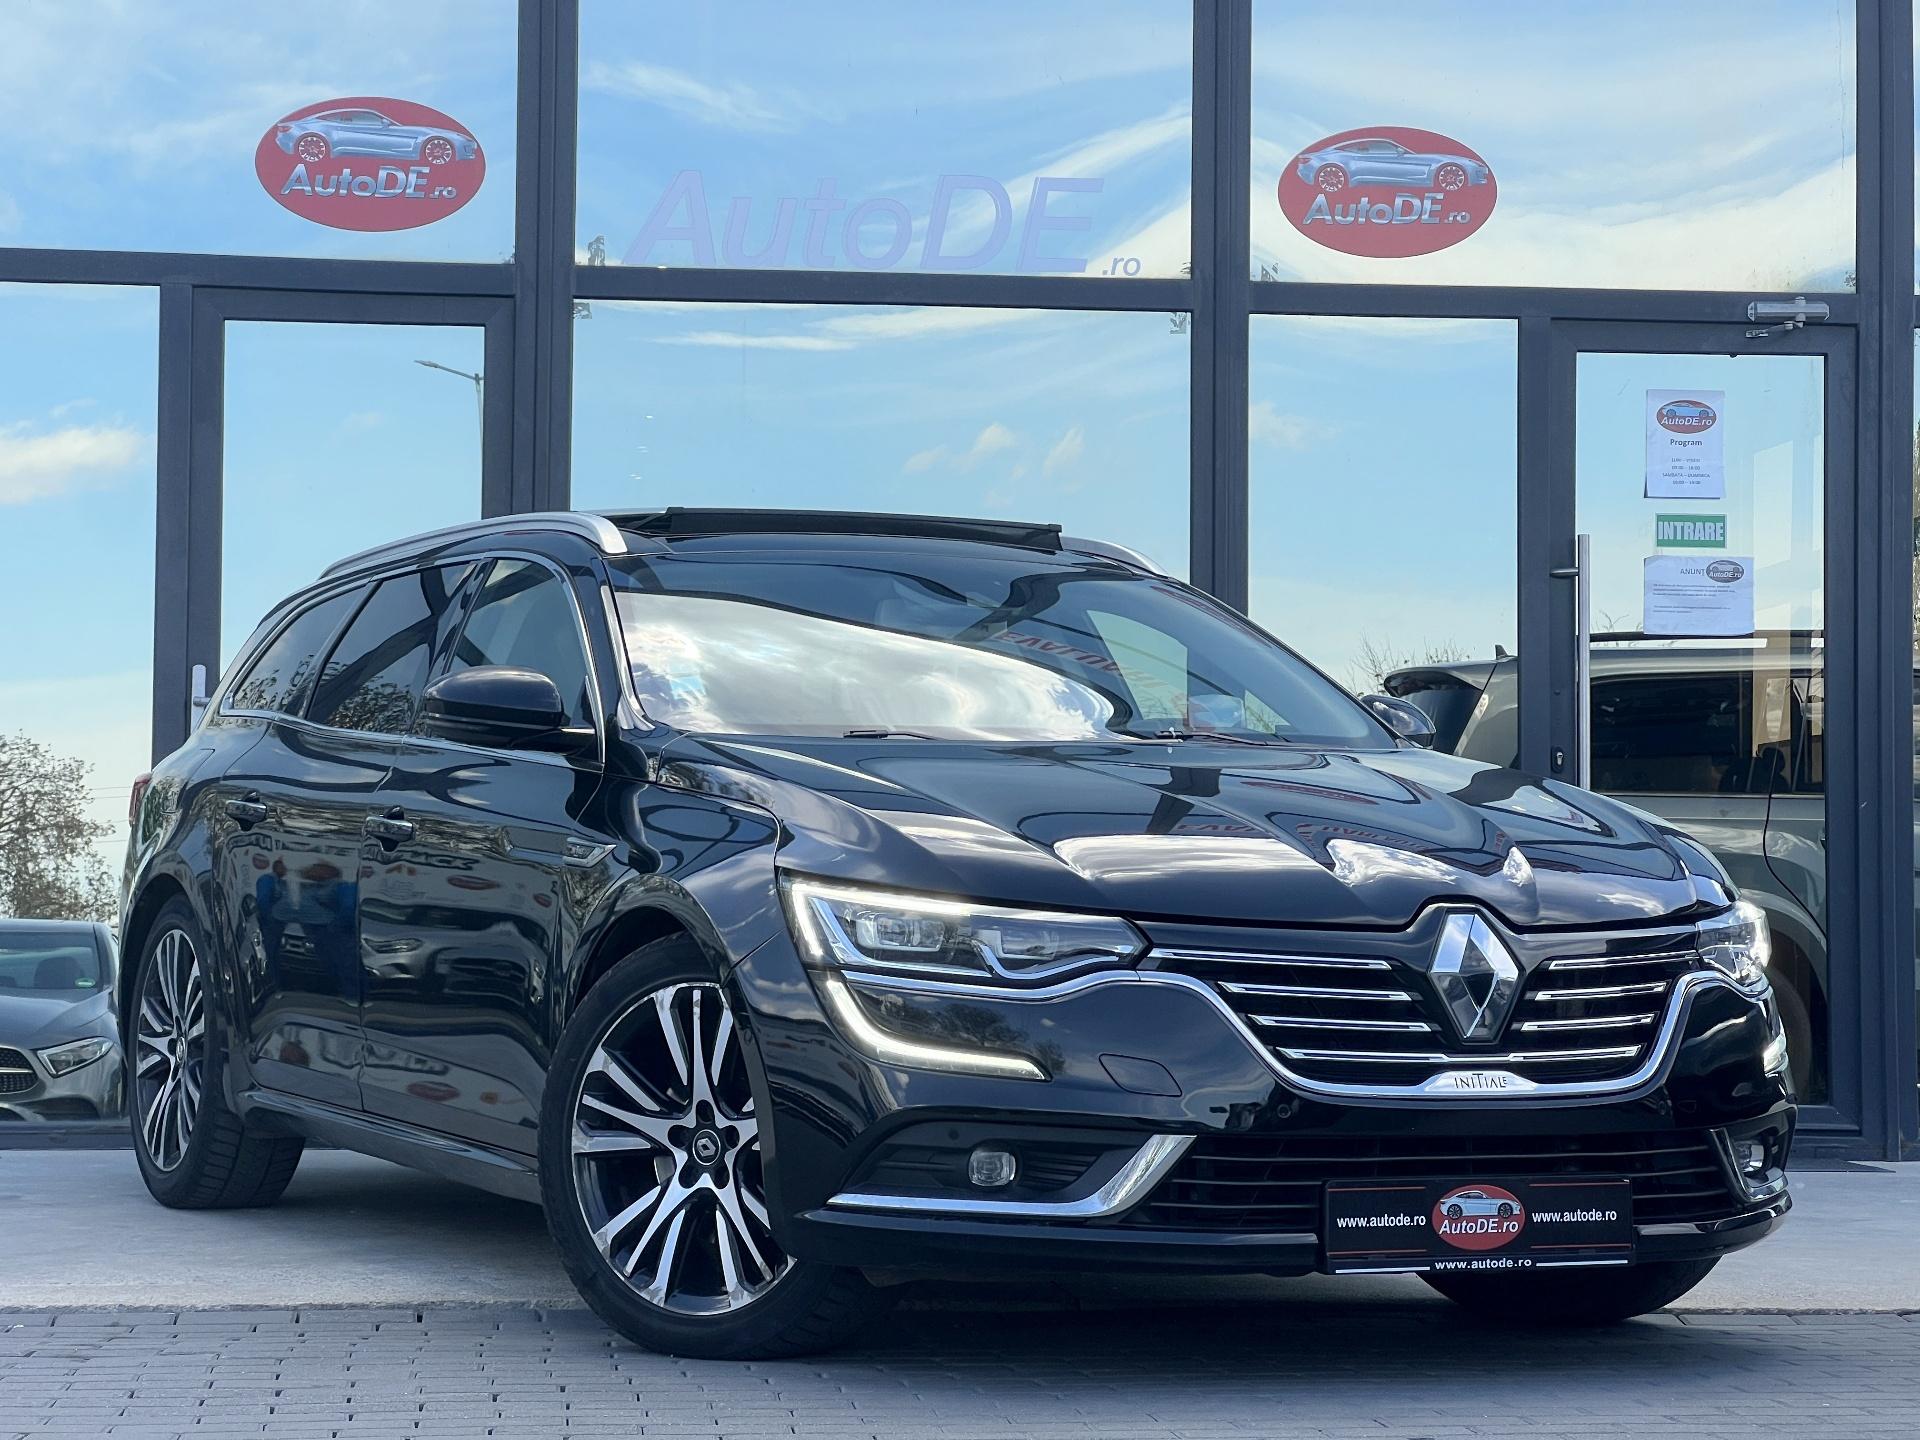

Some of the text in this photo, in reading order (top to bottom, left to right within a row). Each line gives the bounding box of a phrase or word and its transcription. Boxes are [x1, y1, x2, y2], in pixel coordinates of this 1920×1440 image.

[1660, 416, 1713, 426] AutoDE.ro
[1670, 438, 1703, 447] Program
[1657, 521, 1724, 540] INTRARE
[1454, 1073, 1507, 1088] INITIALE
[1337, 1212, 1426, 1228] www.autode.ro
[1532, 1207, 1617, 1224] www.autode.ro
[1439, 1218, 1519, 1235] AutoDE.ro
[1434, 1257, 1532, 1271] www.autode.ro
